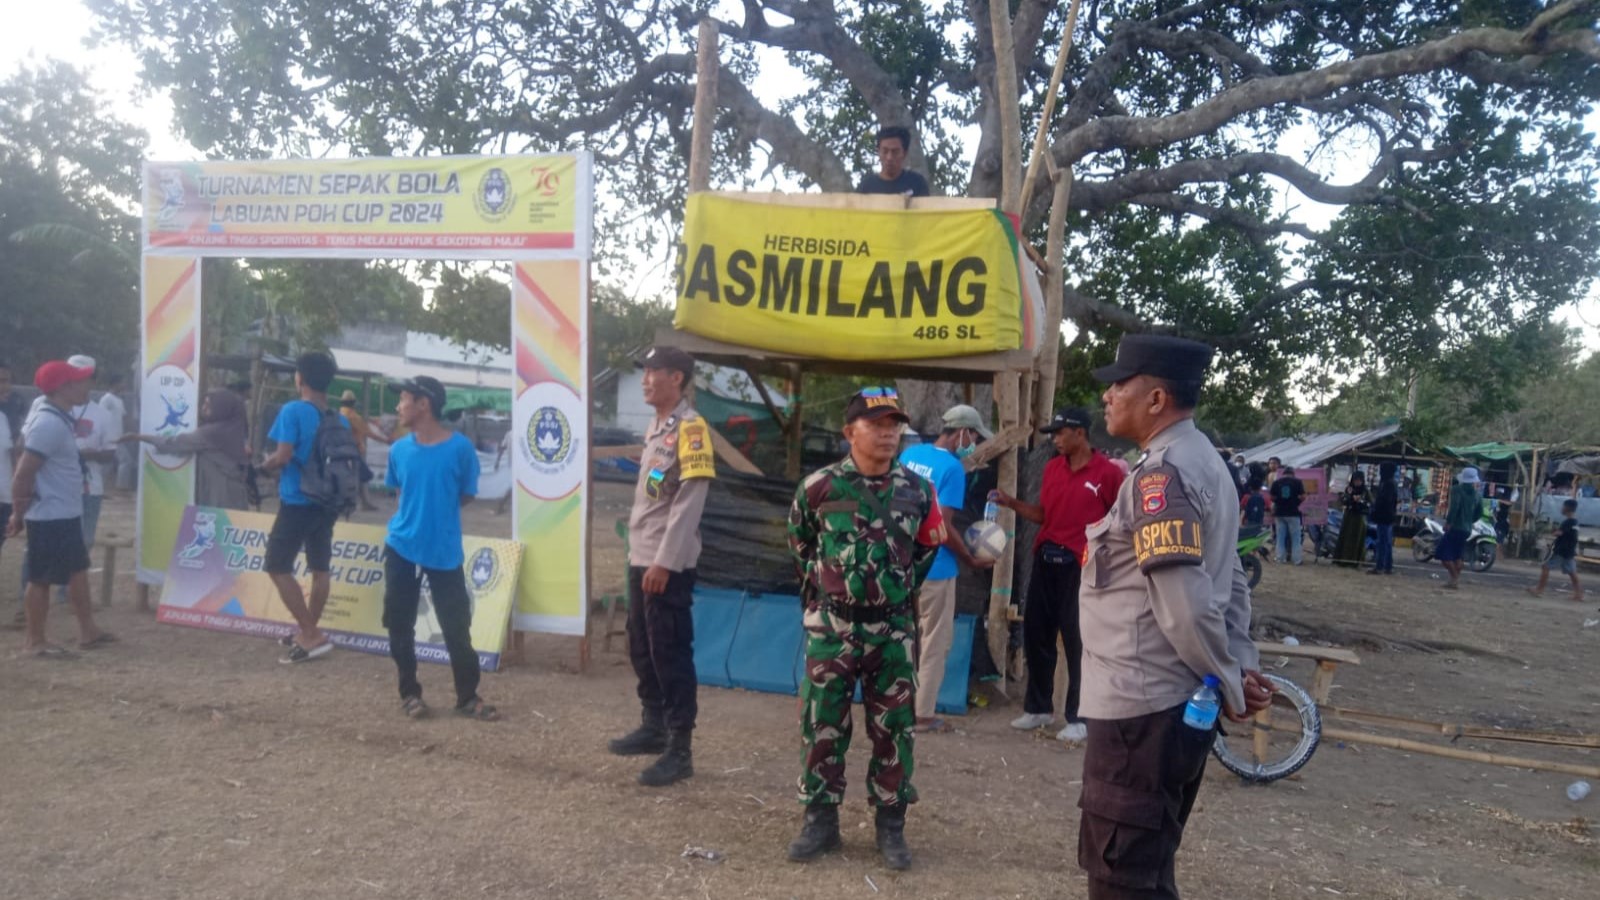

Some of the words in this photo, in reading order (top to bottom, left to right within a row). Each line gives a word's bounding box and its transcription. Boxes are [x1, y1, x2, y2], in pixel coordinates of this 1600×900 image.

[198, 174, 313, 196] TURNAMEN
[318, 173, 391, 195] SEPAK
[396, 172, 461, 194] BOLA
[211, 204, 289, 224] LABUAN
[294, 204, 337, 223] POH
[342, 203, 384, 223] CUP
[389, 203, 444, 223] 2024
[399, 236, 433, 246] UNTUK
[763, 234, 871, 257] HERBISIDA
[675, 243, 988, 319] BASMILANG
[913, 326, 949, 341] 486
[956, 325, 981, 340] SL
[223, 528, 270, 549] TURN
[1142, 520, 1184, 550] SPKT
[345, 567, 383, 586] CUP
[232, 619, 291, 636] SPORTIVITAS
